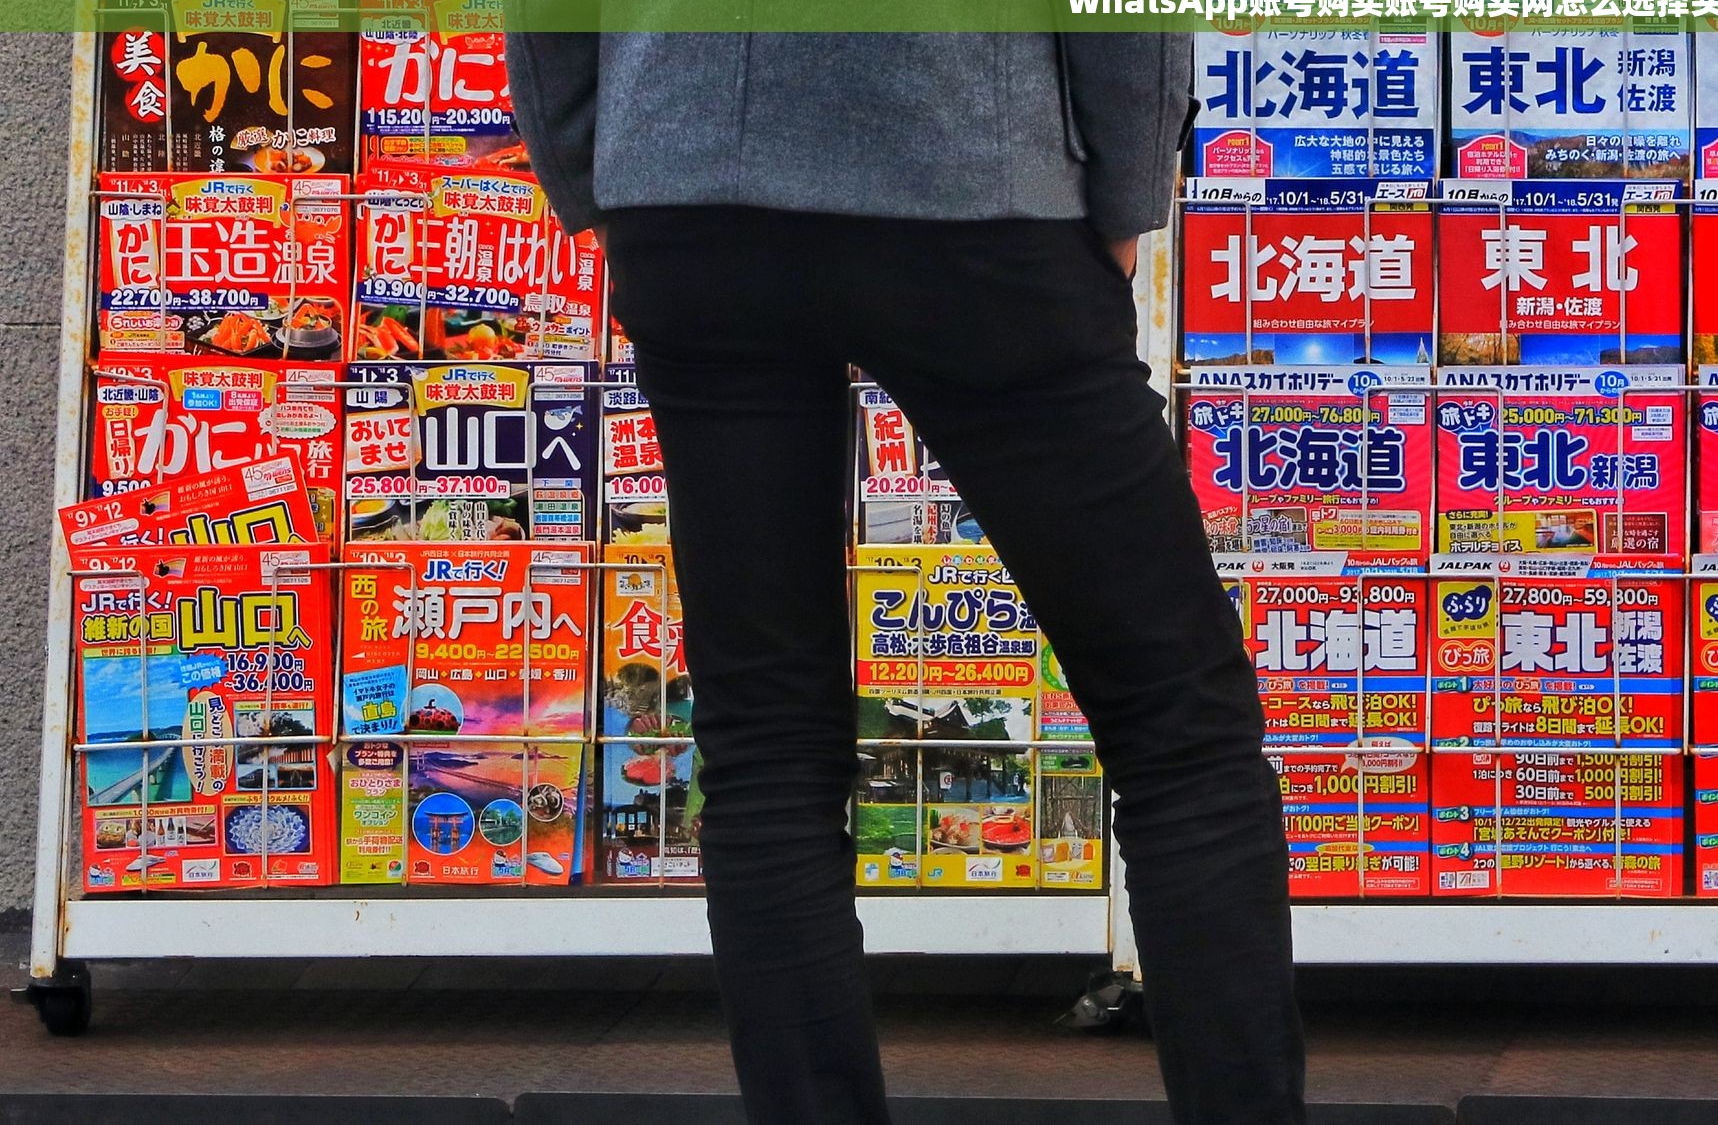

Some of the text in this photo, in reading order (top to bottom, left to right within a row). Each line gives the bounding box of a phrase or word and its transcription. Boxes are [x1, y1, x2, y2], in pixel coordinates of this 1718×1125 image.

[117, 32, 165, 117] 美食
[1617, 49, 1676, 78] 新潟
[176, 42, 335, 122] かに
[1205, 49, 1421, 120] 北海道
[1462, 46, 1606, 116] 東北
[1617, 83, 1676, 113] 佐渡
[202, 179, 254, 193] JRで行く
[442, 176, 533, 196] スーパーはくとで行く
[185, 196, 273, 214] 味覚太鼓判
[445, 192, 532, 214] 味覚太鼓判
[165, 221, 338, 285] 玉造温泉
[1480, 225, 1639, 293] 東北
[1210, 233, 1415, 303] 北海道
[1516, 296, 1603, 317] 新潟・佐渡
[442, 368, 495, 382] JRで行く
[355, 390, 389, 404] 山陽
[109, 422, 134, 473] 日帰り
[424, 410, 581, 472] 山口へ
[1590, 453, 1660, 490] 新潟
[424, 559, 506, 581] JRで行く!
[1438, 561, 1493, 571] JALPAK
[178, 587, 310, 650] 山口へ
[351, 576, 388, 641] 西の旅
[392, 587, 581, 639] 瀬戸内へ
[1446, 597, 1489, 617] ふらり
[82, 614, 174, 642] 維新の国
[228, 653, 304, 672] 16,900円
[362, 703, 397, 722] 直島
[350, 777, 402, 789] おひとりさま
[442, 865, 478, 876] 日本旅行
